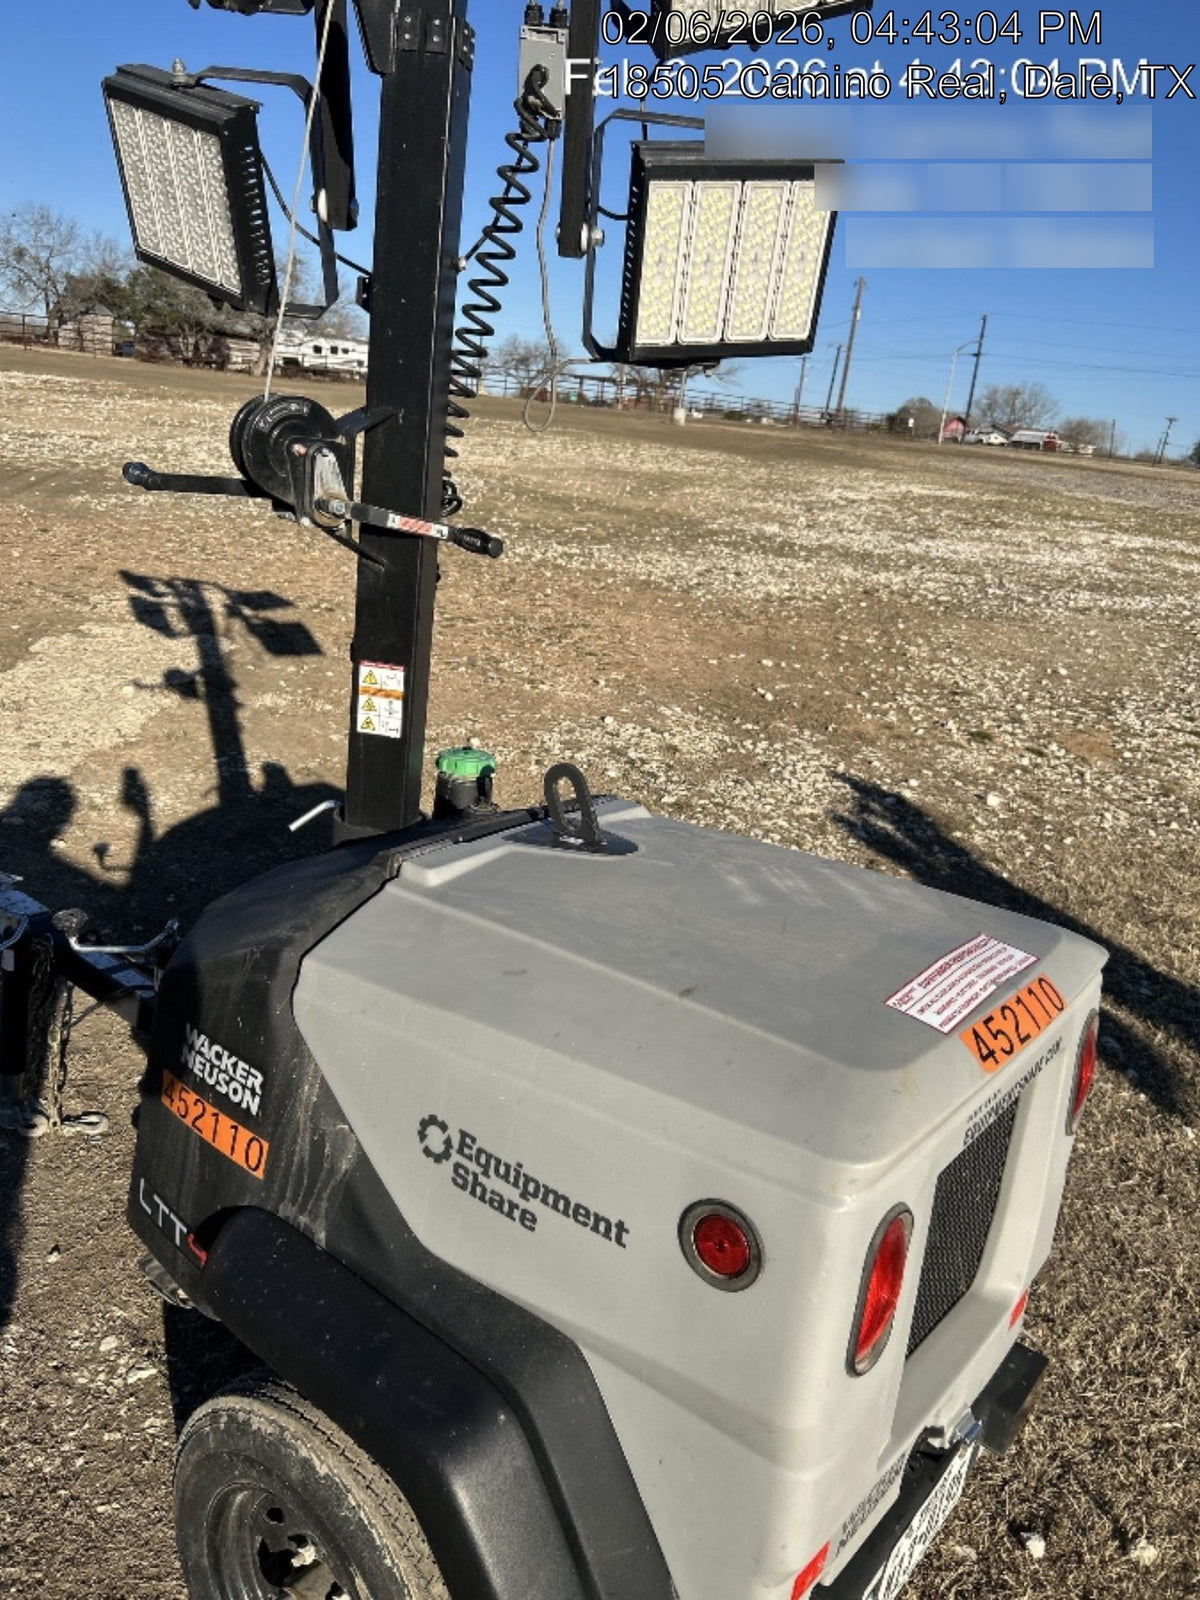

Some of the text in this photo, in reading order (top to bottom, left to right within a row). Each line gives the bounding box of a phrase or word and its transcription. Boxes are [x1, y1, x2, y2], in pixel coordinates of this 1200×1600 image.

[186, 1022, 264, 1095] WACKER
[971, 976, 1065, 1065] 452110
[181, 1044, 260, 1116] NEUSON
[164, 1077, 264, 1172] 452110
[451, 1161, 538, 1233] Share
[456, 1128, 630, 1249] Equipment
